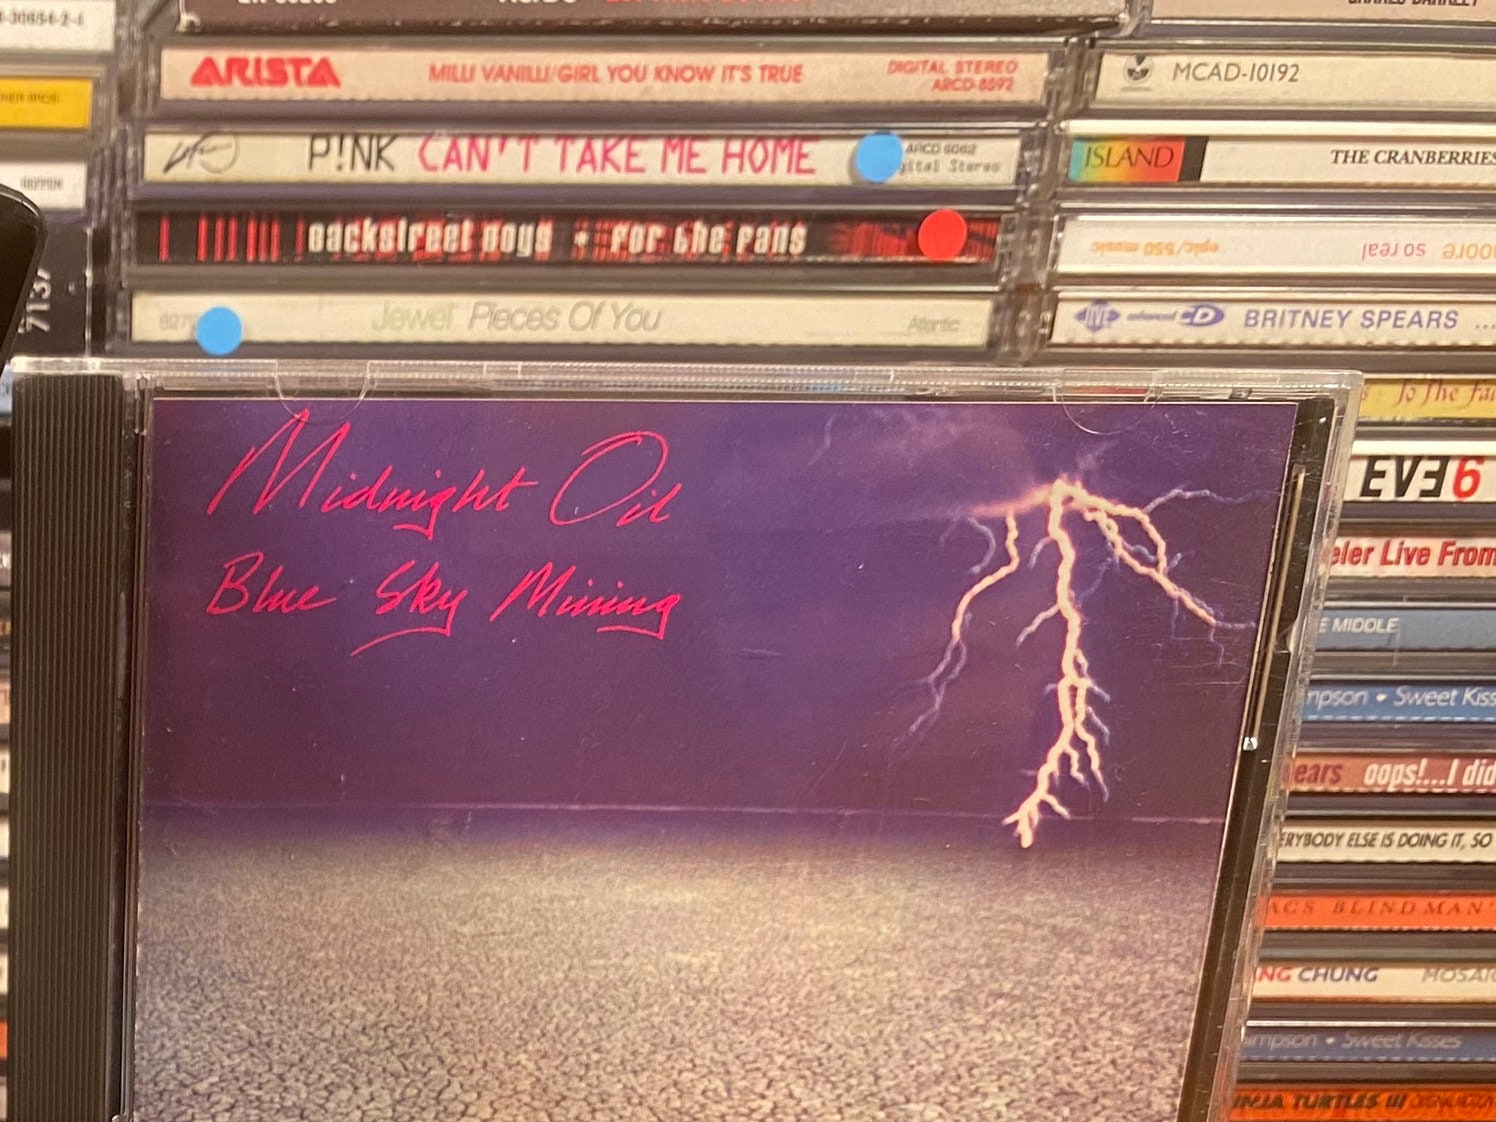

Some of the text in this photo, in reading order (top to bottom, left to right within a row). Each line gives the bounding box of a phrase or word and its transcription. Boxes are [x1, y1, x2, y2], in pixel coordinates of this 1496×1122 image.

[190, 56, 341, 87] ARISTA
[607, 64, 648, 83] YOU
[654, 64, 715, 83] KNOW
[722, 65, 753, 83] IT'S
[759, 65, 803, 84] TRUE
[887, 60, 1018, 75] DIGITAL STEREO
[1171, 61, 1301, 84] MCAD-10192
[307, 133, 822, 176] P!NK CAN'T TAKE ME HOME
[947, 158, 1001, 174] Stereo
[1083, 144, 1371, 169] ISLAND THE
[1361, 243, 1427, 259] so real
[370, 302, 455, 332] Jewel
[467, 301, 562, 331] Pieces
[568, 302, 605, 331] Of
[609, 303, 664, 333] You
[1243, 308, 1460, 331] BRITNEY SPEARS
[206, 408, 683, 541] Midnight Oil
[1380, 539, 1432, 568] Live
[205, 550, 683, 658] Blue Sky Mining
[1331, 616, 1400, 635] MIDDLE
[1393, 684, 1459, 708] Sweet
[1346, 831, 1493, 852] ELSE IS DOING IT, SO
[1332, 899, 1416, 916] BLIND
[1297, 966, 1380, 985] CHUNG
[1341, 1030, 1463, 1049] Sweet Kisses
[1292, 1092, 1380, 1110] TURTLES
